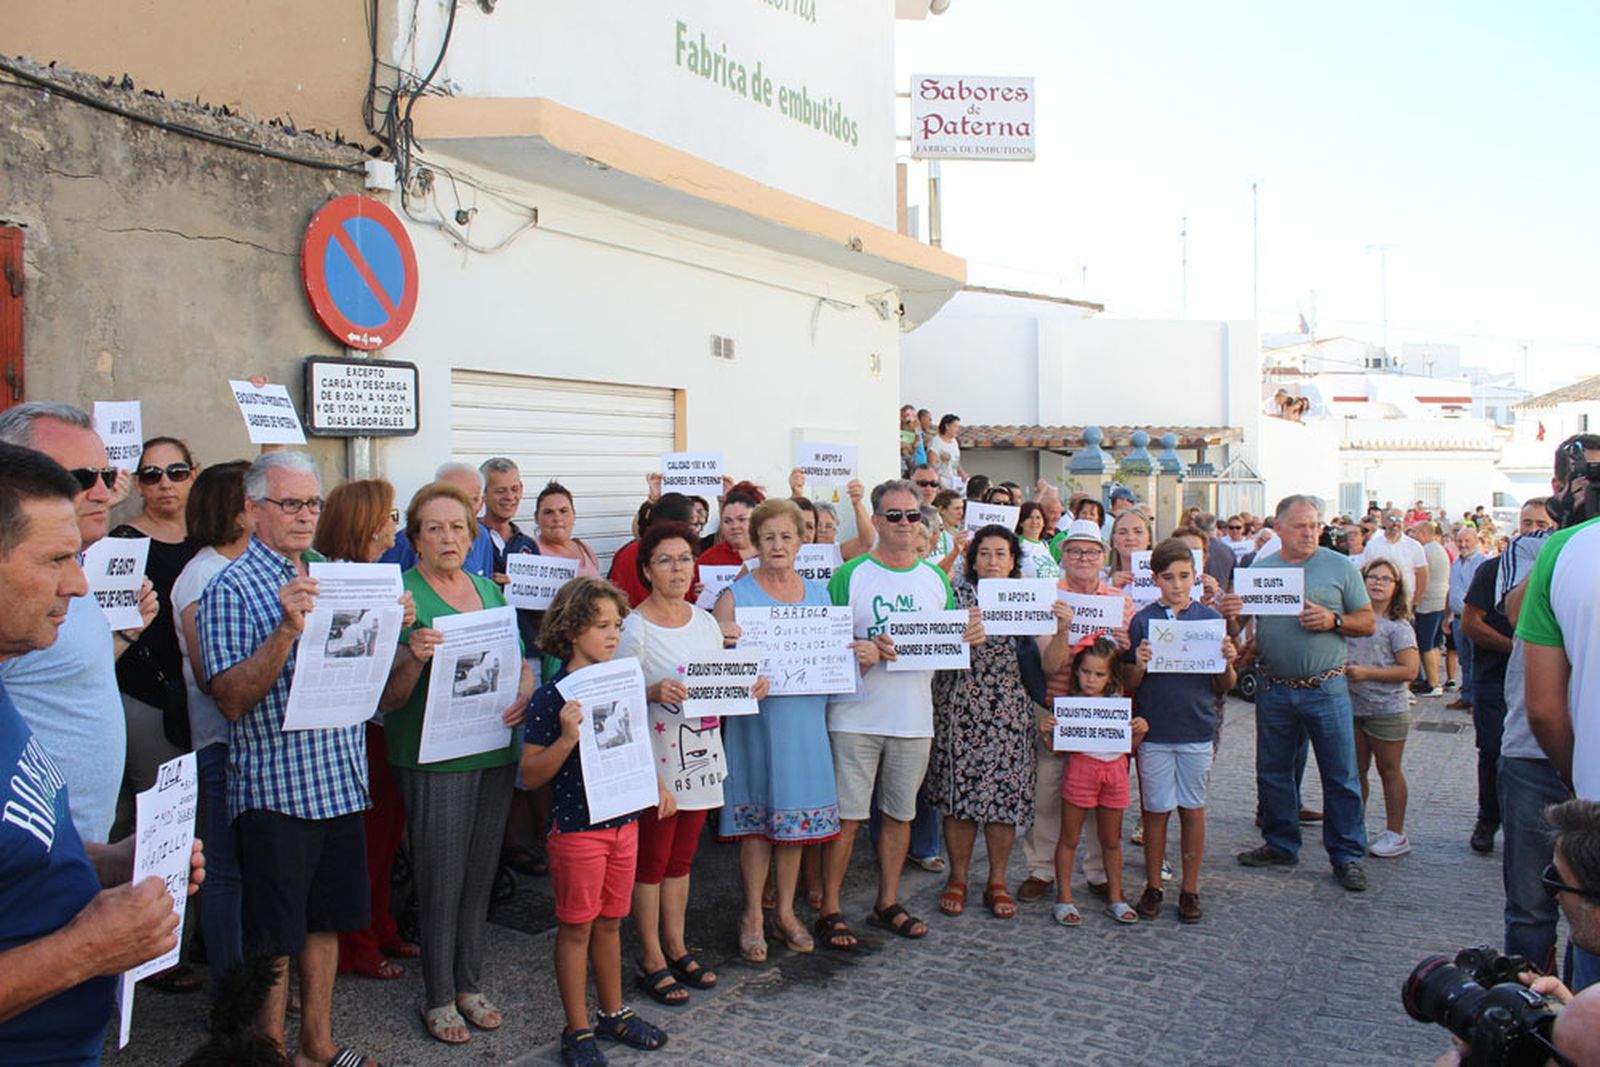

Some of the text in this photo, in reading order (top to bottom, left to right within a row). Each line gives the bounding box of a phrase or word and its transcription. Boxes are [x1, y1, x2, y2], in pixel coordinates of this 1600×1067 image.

[675, 19, 858, 147] Fabrica de embutidos
[920, 78, 1029, 102] Sabores
[967, 103, 981, 115] de
[916, 113, 1031, 140] Paterna
[975, 145, 1033, 154] EMBUTIDOS
[346, 367, 385, 378] EXCEPTO
[321, 378, 407, 391] CARGA Y DESCARGA
[321, 391, 332, 401] DE
[323, 404, 335, 414] DE
[351, 416, 404, 427] LABORABLES
[663, 475, 687, 485] SABORES
[688, 475, 696, 485] DE
[508, 562, 539, 576] SABORES
[539, 565, 548, 578] DE
[817, 567, 831, 580] DE
[1263, 578, 1284, 588] GUSTA
[511, 583, 539, 597] CALIDAD
[1007, 591, 1030, 602] APOYO
[1264, 594, 1273, 604] DE
[1274, 594, 1301, 605] PATERNA
[770, 606, 828, 619] BARTOLO
[982, 610, 1054, 622] SABORES DE PATERNA
[1076, 607, 1098, 618] APOYO
[890, 622, 967, 636] EXQUISITOS PRODUCTOS
[1081, 624, 1090, 635] DE
[894, 643, 962, 656] SABORES DE PATERNA
[686, 662, 723, 677] EXQUISITOS
[723, 662, 758, 677] PRODUCTOS
[1155, 655, 1216, 671] PATERNA
[687, 685, 749, 700] SABORES DE PATERNA
[1056, 706, 1129, 721] EXQUISITOS PRODUCTOS
[1060, 725, 1126, 740] SABORES DE PATERNA
[674, 777, 692, 792] AS
